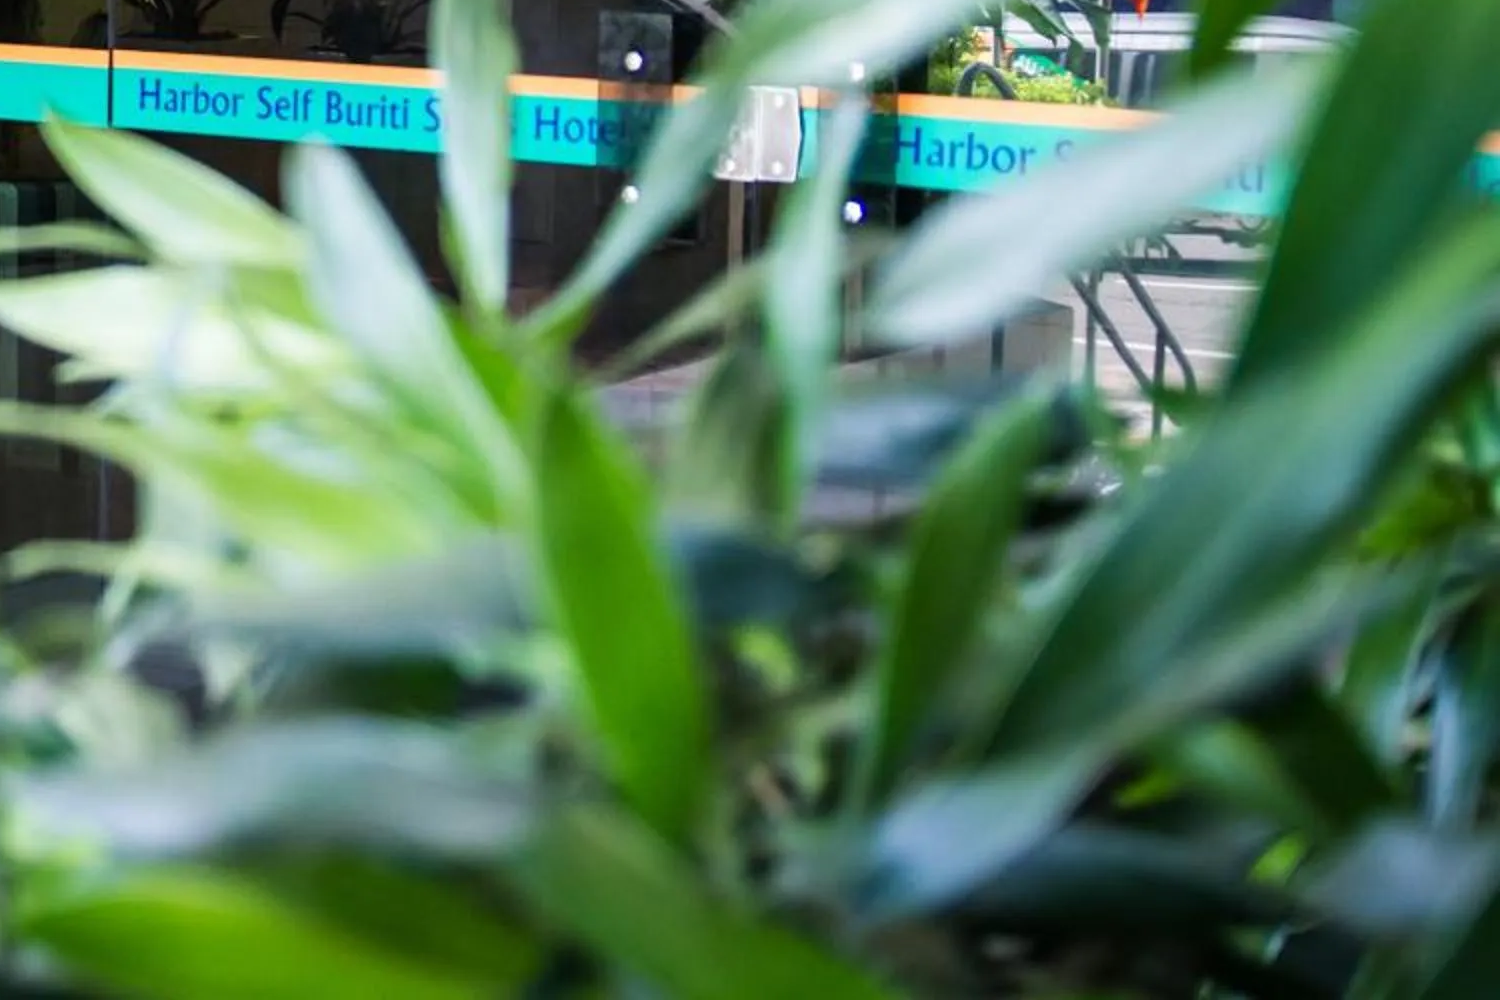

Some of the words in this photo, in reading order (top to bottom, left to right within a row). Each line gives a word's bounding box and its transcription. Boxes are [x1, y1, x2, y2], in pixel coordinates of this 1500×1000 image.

[139, 78, 243, 117] Harbor
[256, 85, 312, 122] Self
[325, 93, 409, 130] Buriti
[534, 104, 627, 146] Hotel
[894, 127, 1036, 175] Harbor
